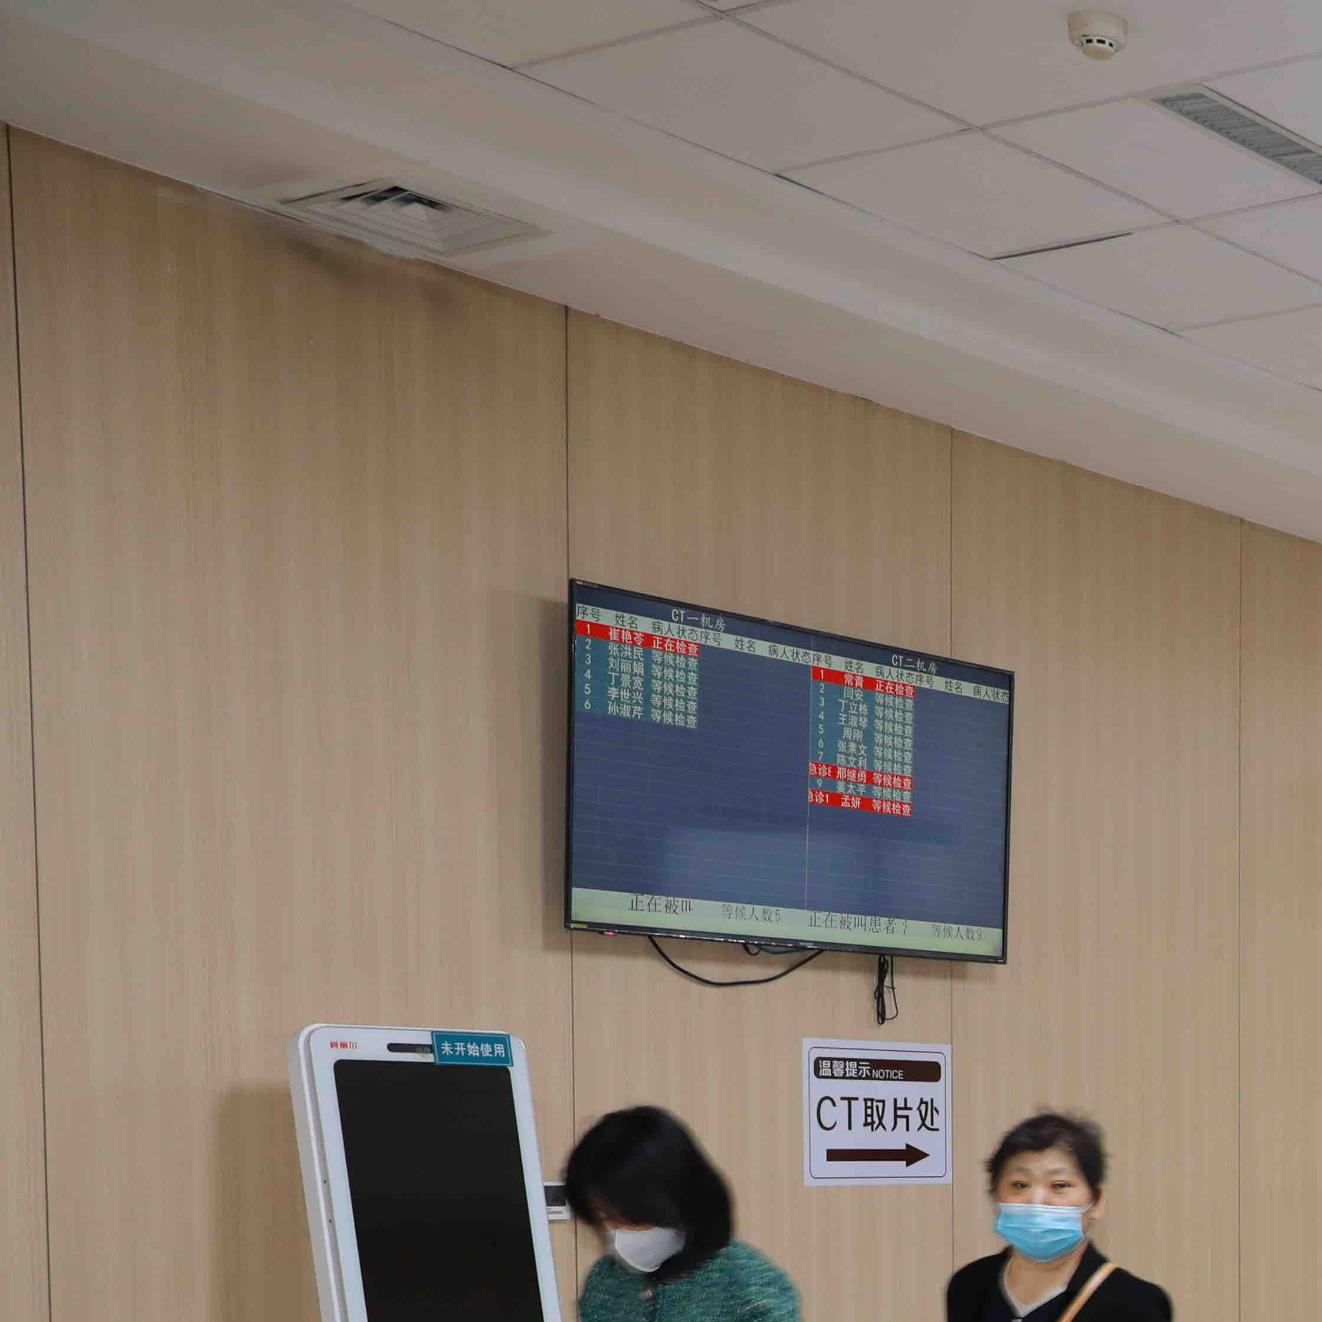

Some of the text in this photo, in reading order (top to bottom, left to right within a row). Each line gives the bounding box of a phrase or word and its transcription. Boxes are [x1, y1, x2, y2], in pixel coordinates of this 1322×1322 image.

[576, 605, 811, 663] 序号 姓名 病人状态 序号 姓名 病人状态
[584, 638, 591, 650] 2
[652, 635, 699, 657] 正在检查
[584, 653, 591, 665] 3
[584, 668, 591, 680] 4
[584, 683, 591, 695] 5
[875, 679, 914, 698] 正在检查
[584, 698, 591, 710] 6
[440, 1040, 506, 1058] 未开始使用
[818, 1059, 904, 1080] 温馨提示 NOTICE
[816, 1095, 940, 1133] CT取片处
